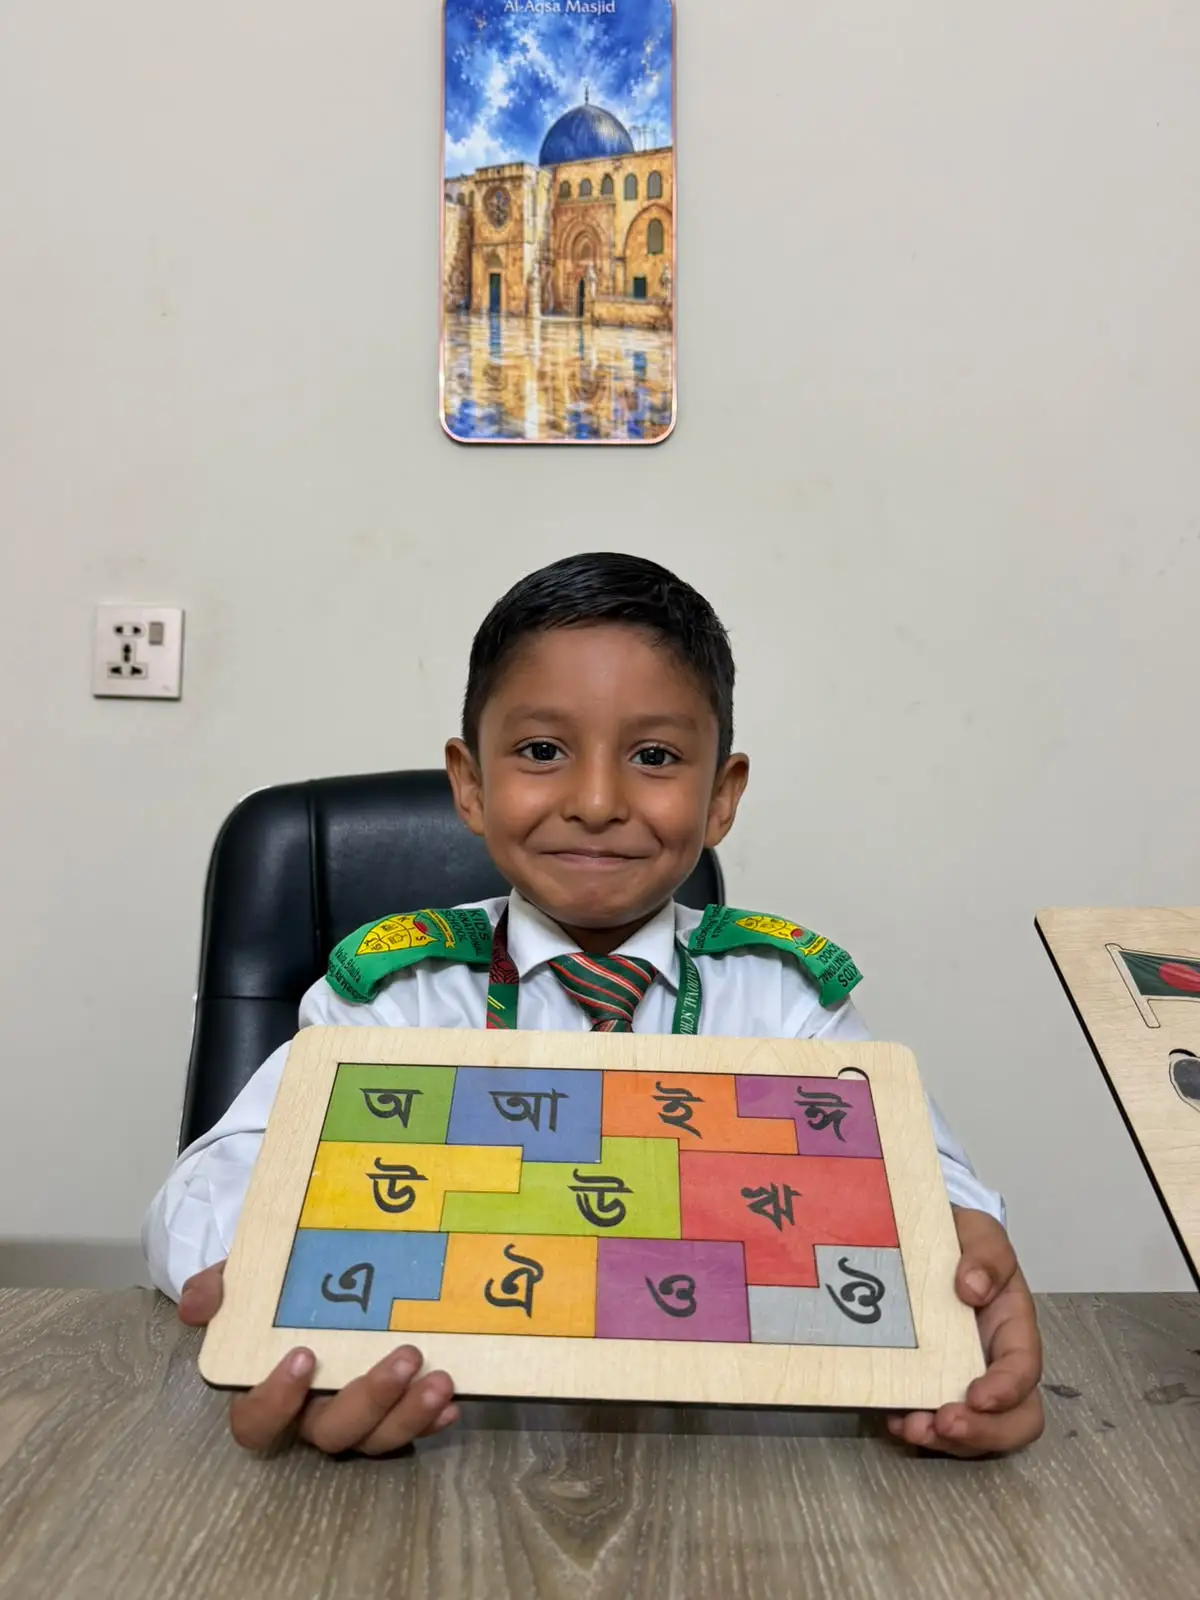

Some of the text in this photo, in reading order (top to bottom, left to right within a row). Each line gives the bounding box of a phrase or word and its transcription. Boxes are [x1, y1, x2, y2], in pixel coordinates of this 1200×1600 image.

[504, 0, 616, 15] Al-Aqsa Masjid
[469, 909, 490, 941] KIDS
[360, 1082, 853, 1141] অ আ ই ঈ
[366, 1157, 800, 1230] উ ঊ ঋ
[321, 1245, 885, 1325] এ ঐ ও ঔ
